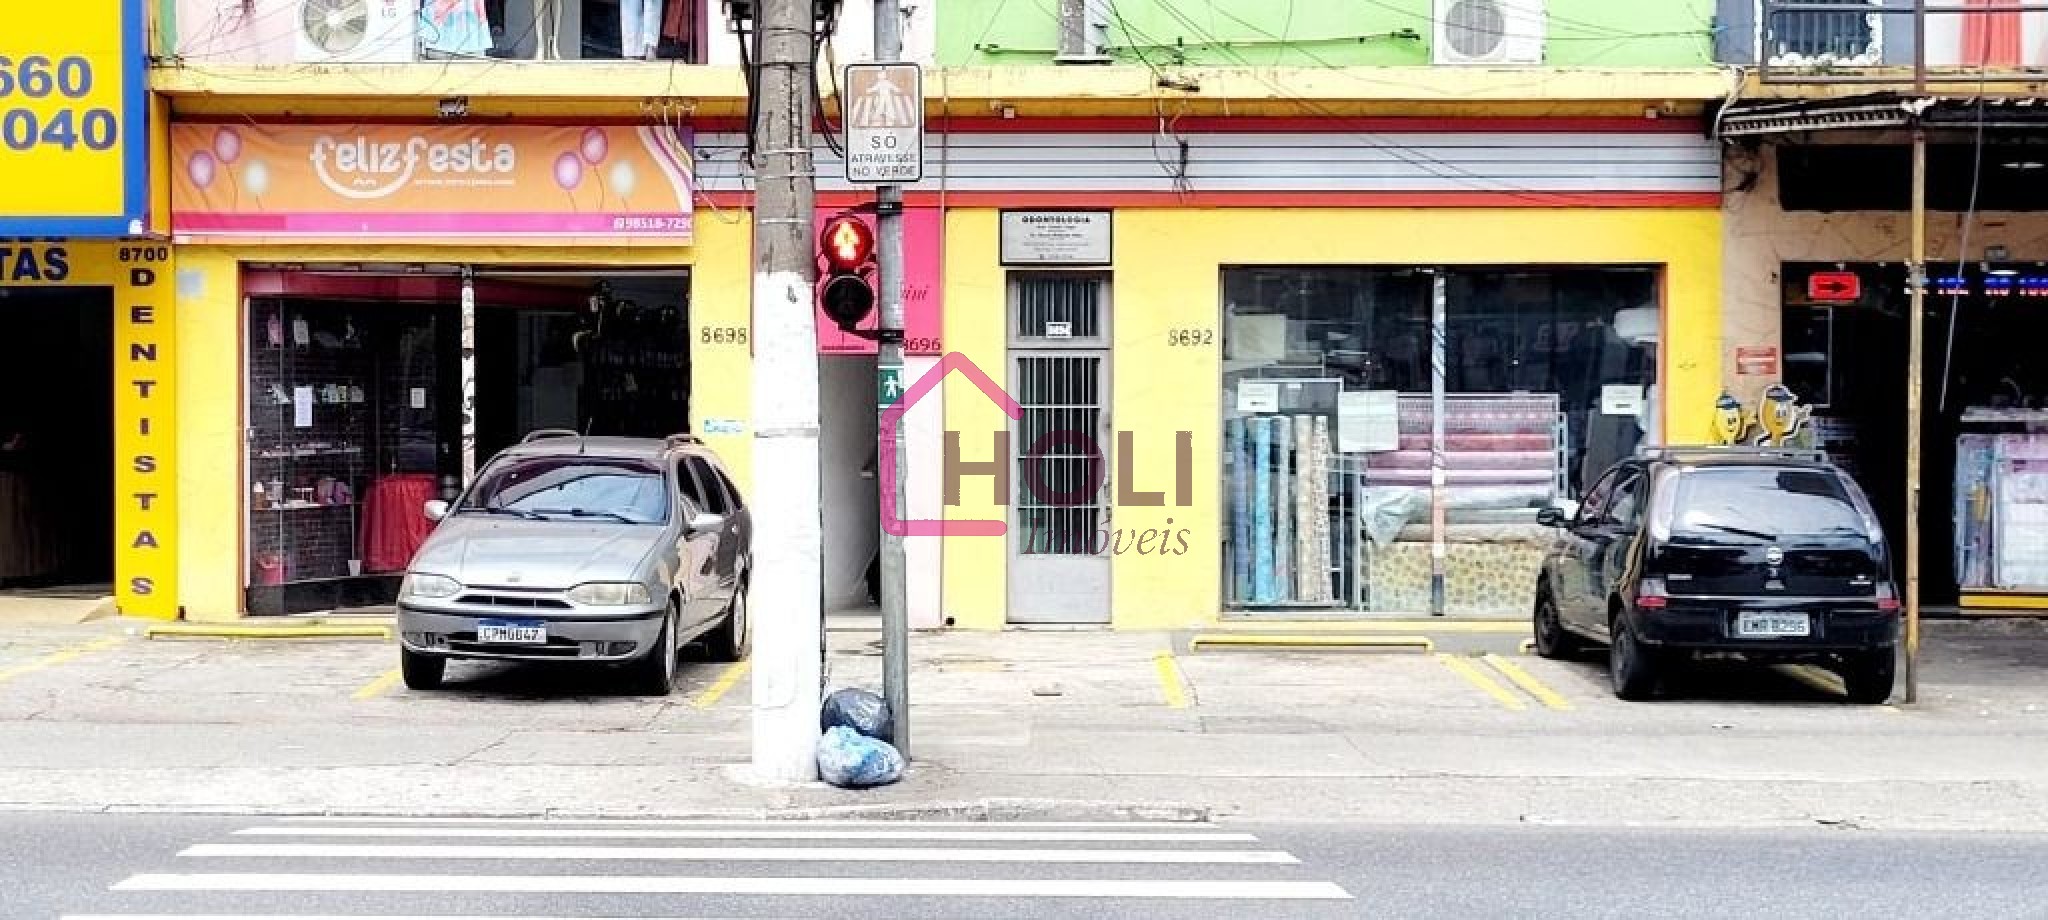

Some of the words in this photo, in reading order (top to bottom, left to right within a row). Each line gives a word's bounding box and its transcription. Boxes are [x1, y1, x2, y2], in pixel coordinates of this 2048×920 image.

[3, 108, 116, 150] 040
[851, 153, 917, 163] ATRAVESSE
[852, 166, 870, 176] NO
[875, 166, 917, 176] VERDE
[119, 247, 169, 262] 8700
[701, 327, 747, 344] 8698
[1167, 329, 1213, 346] 8692
[130, 268, 158, 595] DENTISTAS
